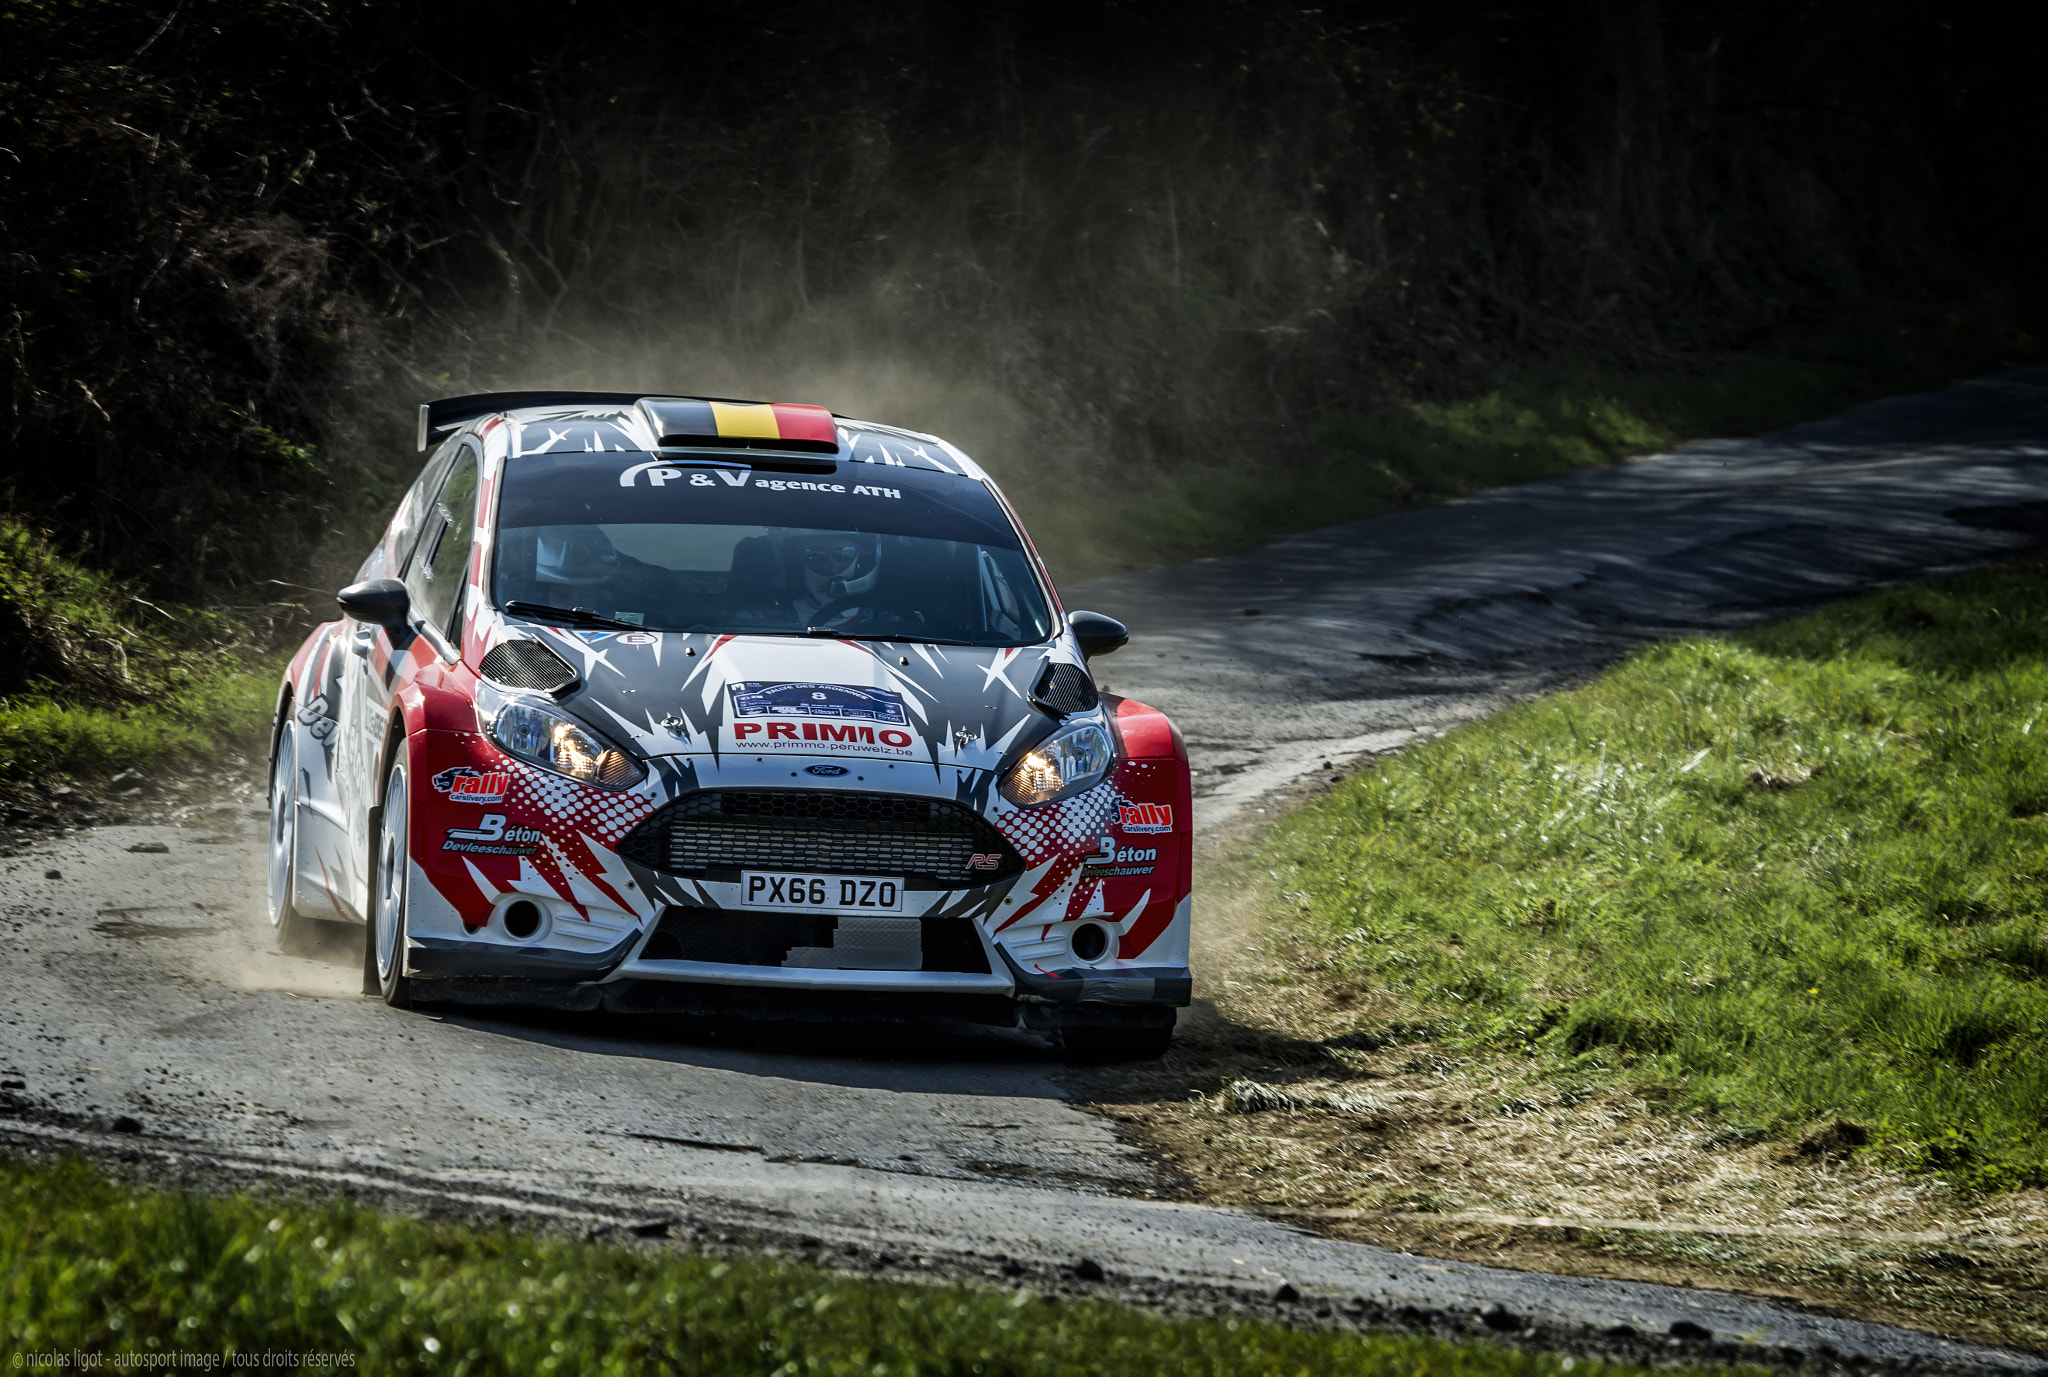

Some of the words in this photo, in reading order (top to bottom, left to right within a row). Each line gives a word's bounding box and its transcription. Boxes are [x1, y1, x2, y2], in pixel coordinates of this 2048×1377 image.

[648, 468, 682, 486] P
[690, 473, 716, 488] &
[714, 468, 751, 486] V
[755, 478, 846, 493] agence
[853, 485, 901, 499] ATH
[811, 692, 827, 700] 8
[818, 684, 869, 700] ARDENNES
[736, 740, 914, 757] www.primmo.peruwelz.be
[811, 765, 842, 775] Ford
[451, 772, 511, 796] rally
[1118, 803, 1173, 826] rally
[447, 813, 541, 843] Béton
[441, 841, 538, 856] Devleeschauwer
[1085, 836, 1156, 865] Béton
[965, 853, 1002, 870] RS
[1081, 865, 1155, 878] Devleeschauwer
[748, 875, 826, 905] PX66
[839, 880, 896, 908] DZO
